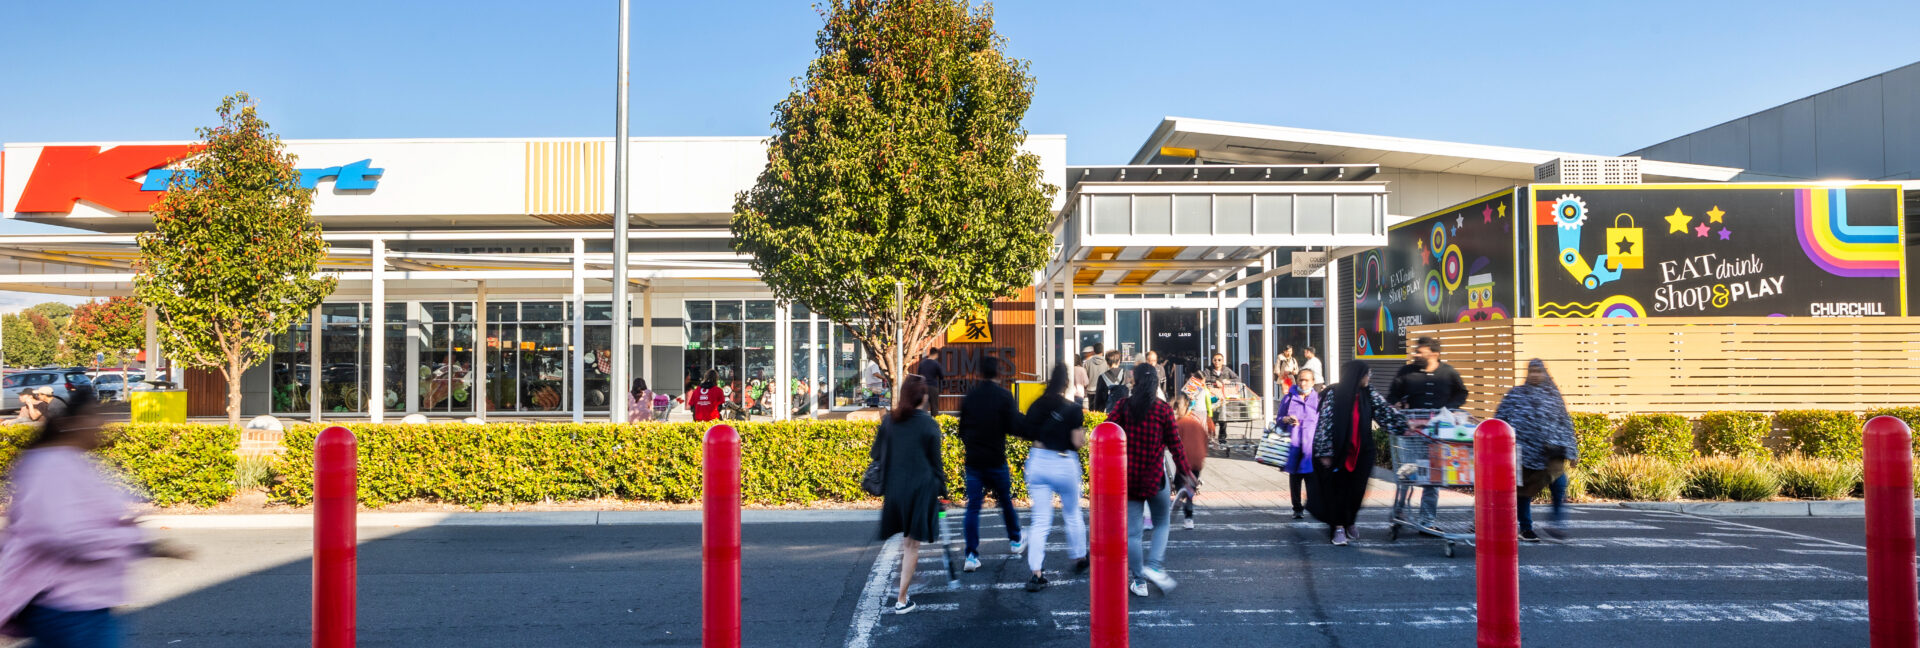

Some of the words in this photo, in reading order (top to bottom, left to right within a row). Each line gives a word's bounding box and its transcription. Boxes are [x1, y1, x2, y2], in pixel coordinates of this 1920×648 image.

[1390, 268, 1404, 288] EAT
[1659, 253, 1716, 284] EAT
[1716, 253, 1764, 280] drink
[1406, 279, 1421, 296] PLAY
[1654, 284, 1711, 312] Shop
[1730, 275, 1784, 302] PLAY
[1810, 302, 1886, 315] CHURCHILL
[965, 315, 988, 340] 家
[1397, 315, 1423, 326] CHURCHILL
